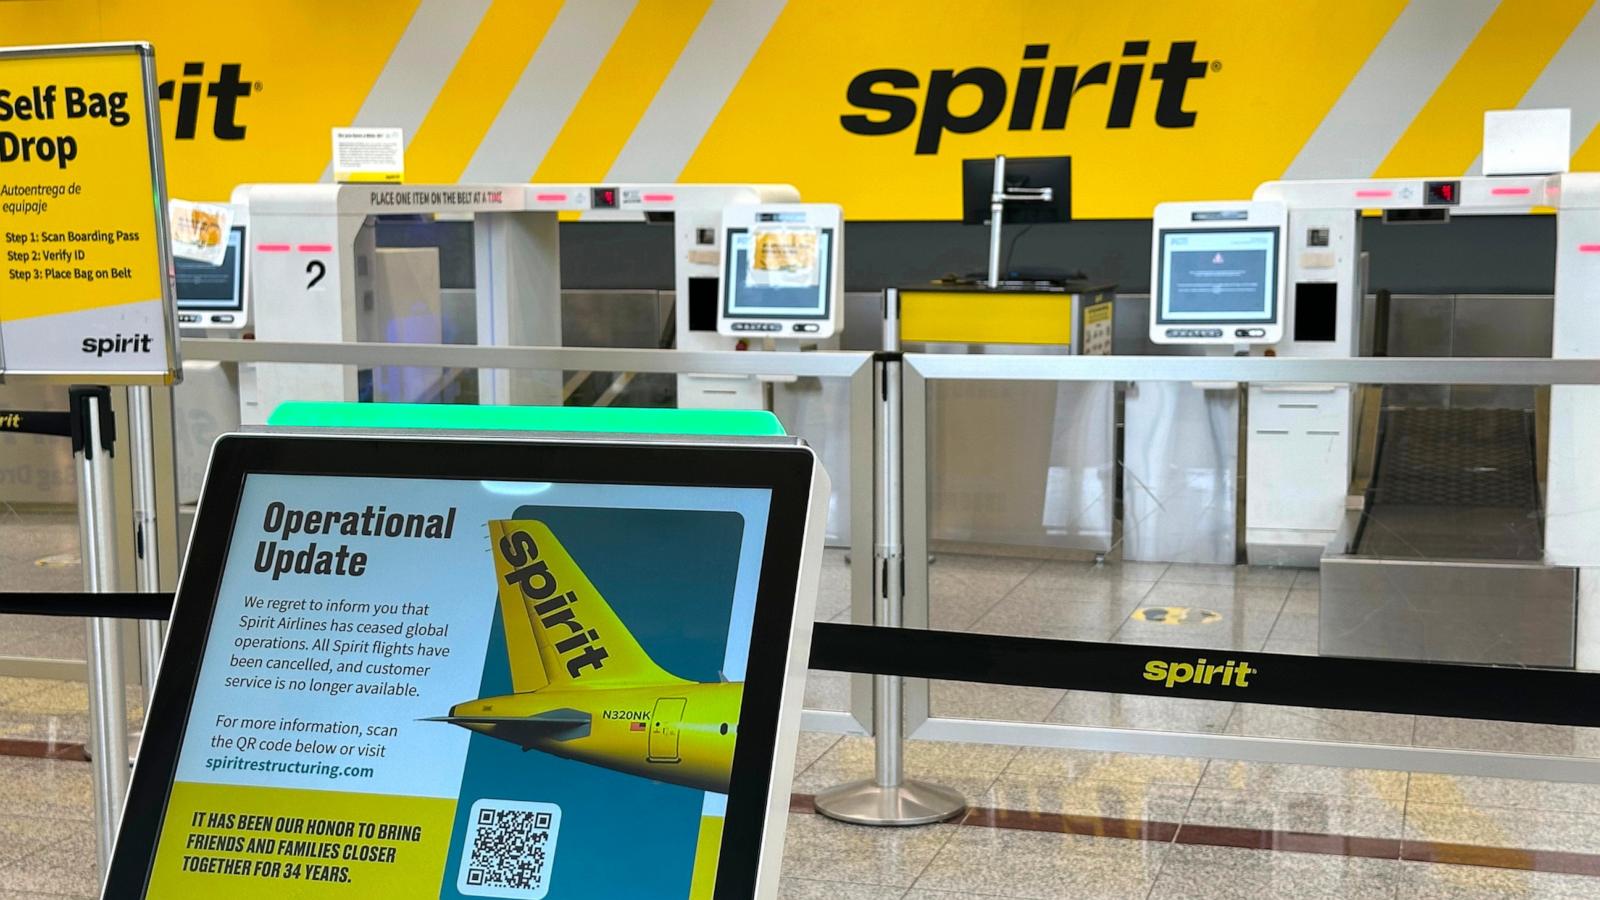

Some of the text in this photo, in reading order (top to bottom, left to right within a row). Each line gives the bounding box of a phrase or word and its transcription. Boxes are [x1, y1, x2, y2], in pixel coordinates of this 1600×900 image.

[0, 86, 130, 126] Self Bag
[0, 131, 78, 169] Drop
[1, 182, 81, 198] Autoentrega de
[371, 191, 394, 205] PLACE
[396, 191, 411, 205] ONE
[413, 191, 429, 205] ITEM
[431, 191, 441, 204] ON
[443, 191, 456, 204] THE
[457, 191, 472, 204] BELT
[474, 191, 481, 203] AT
[482, 191, 486, 203] A
[2, 200, 47, 215] equipaje
[6, 230, 139, 245] Step 1: Scan Boarding Pass
[7, 249, 85, 263] Step 2: Verify ID
[9, 267, 132, 281] Step 3: Place Bag on Belt
[82, 334, 152, 357] spirit
[263, 501, 456, 540] Operational
[254, 541, 368, 580] Update
[244, 595, 430, 617] We regret to inform you that
[500, 530, 609, 679] spirit
[239, 615, 449, 639] Spirit Airlines has ceased global
[234, 636, 450, 658] operations. All Spirit flights have
[230, 654, 431, 677] been cancelled, and customer
[225, 676, 420, 697] service is no longer available.
[215, 714, 398, 738] For more information, scan
[602, 710, 651, 720] N320NK
[211, 734, 386, 758] the QR code below or visit
[206, 756, 374, 779] spiritrestructuring.com
[192, 811, 422, 842] IT HAS BEEN OUR HONOR TO BRING
[186, 834, 397, 863] FRIENDS AND FAMILIES CLOSER
[182, 855, 352, 883] TOGETHER FOR 34 YEARS.
